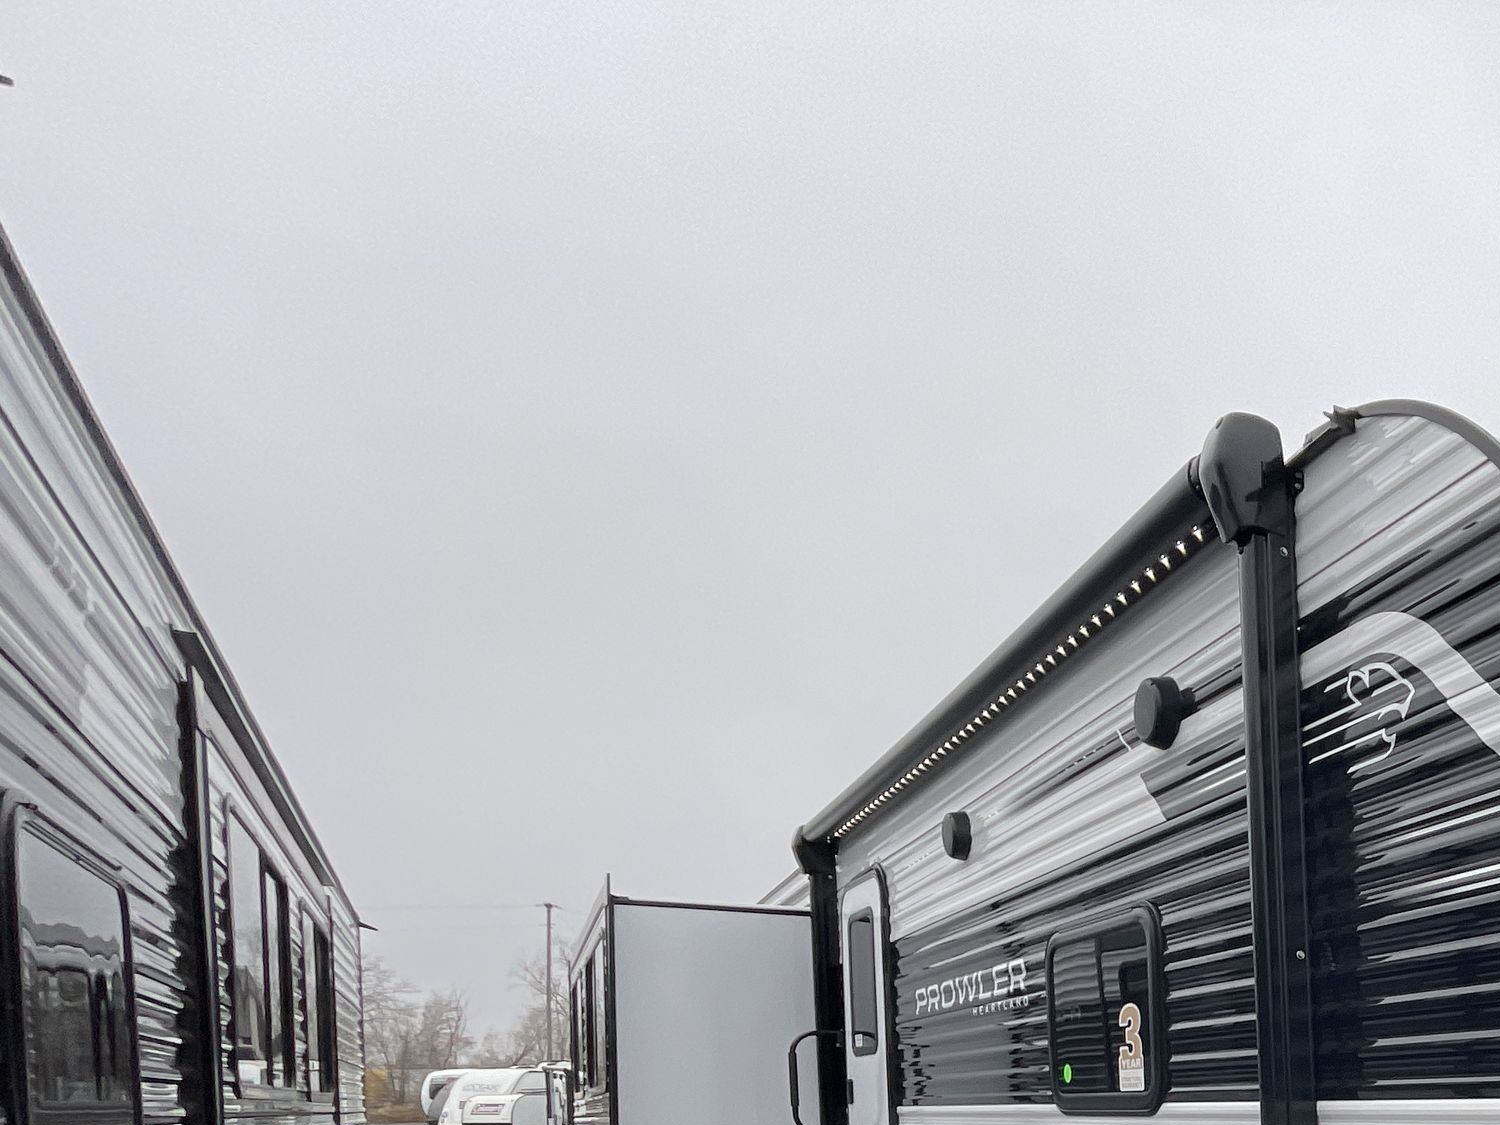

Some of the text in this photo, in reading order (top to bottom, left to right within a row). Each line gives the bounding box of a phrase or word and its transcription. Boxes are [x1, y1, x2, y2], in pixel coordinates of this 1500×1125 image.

[915, 959, 1026, 1015] PROWLER
[972, 996, 1029, 1016] HEARTLAND
[1119, 1003, 1142, 1059] 3
[1121, 1059, 1141, 1069] YEAR
